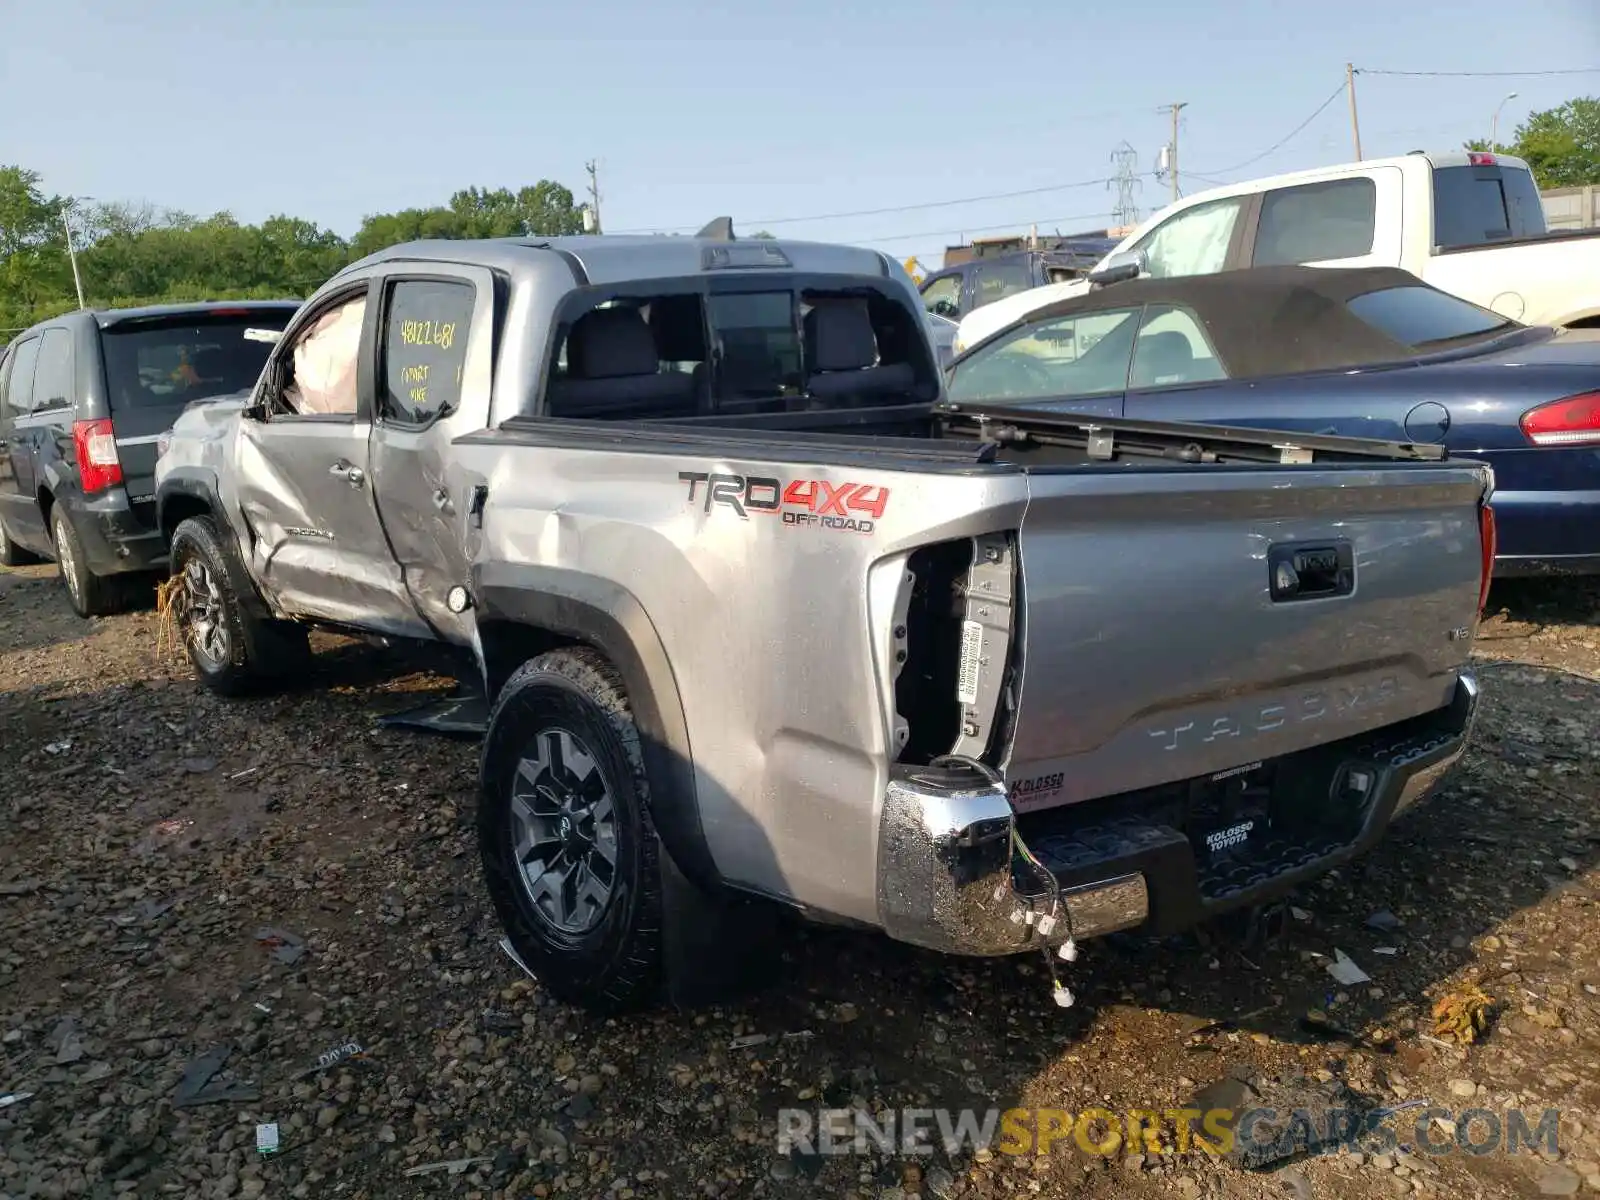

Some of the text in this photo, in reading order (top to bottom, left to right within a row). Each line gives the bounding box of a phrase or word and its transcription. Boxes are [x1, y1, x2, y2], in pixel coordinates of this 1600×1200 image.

[678, 471, 781, 521] TRD
[782, 510, 875, 534] OFF ROAD
[1206, 820, 1254, 845] KOLOSSO
[1210, 832, 1248, 852] TOYOTA
